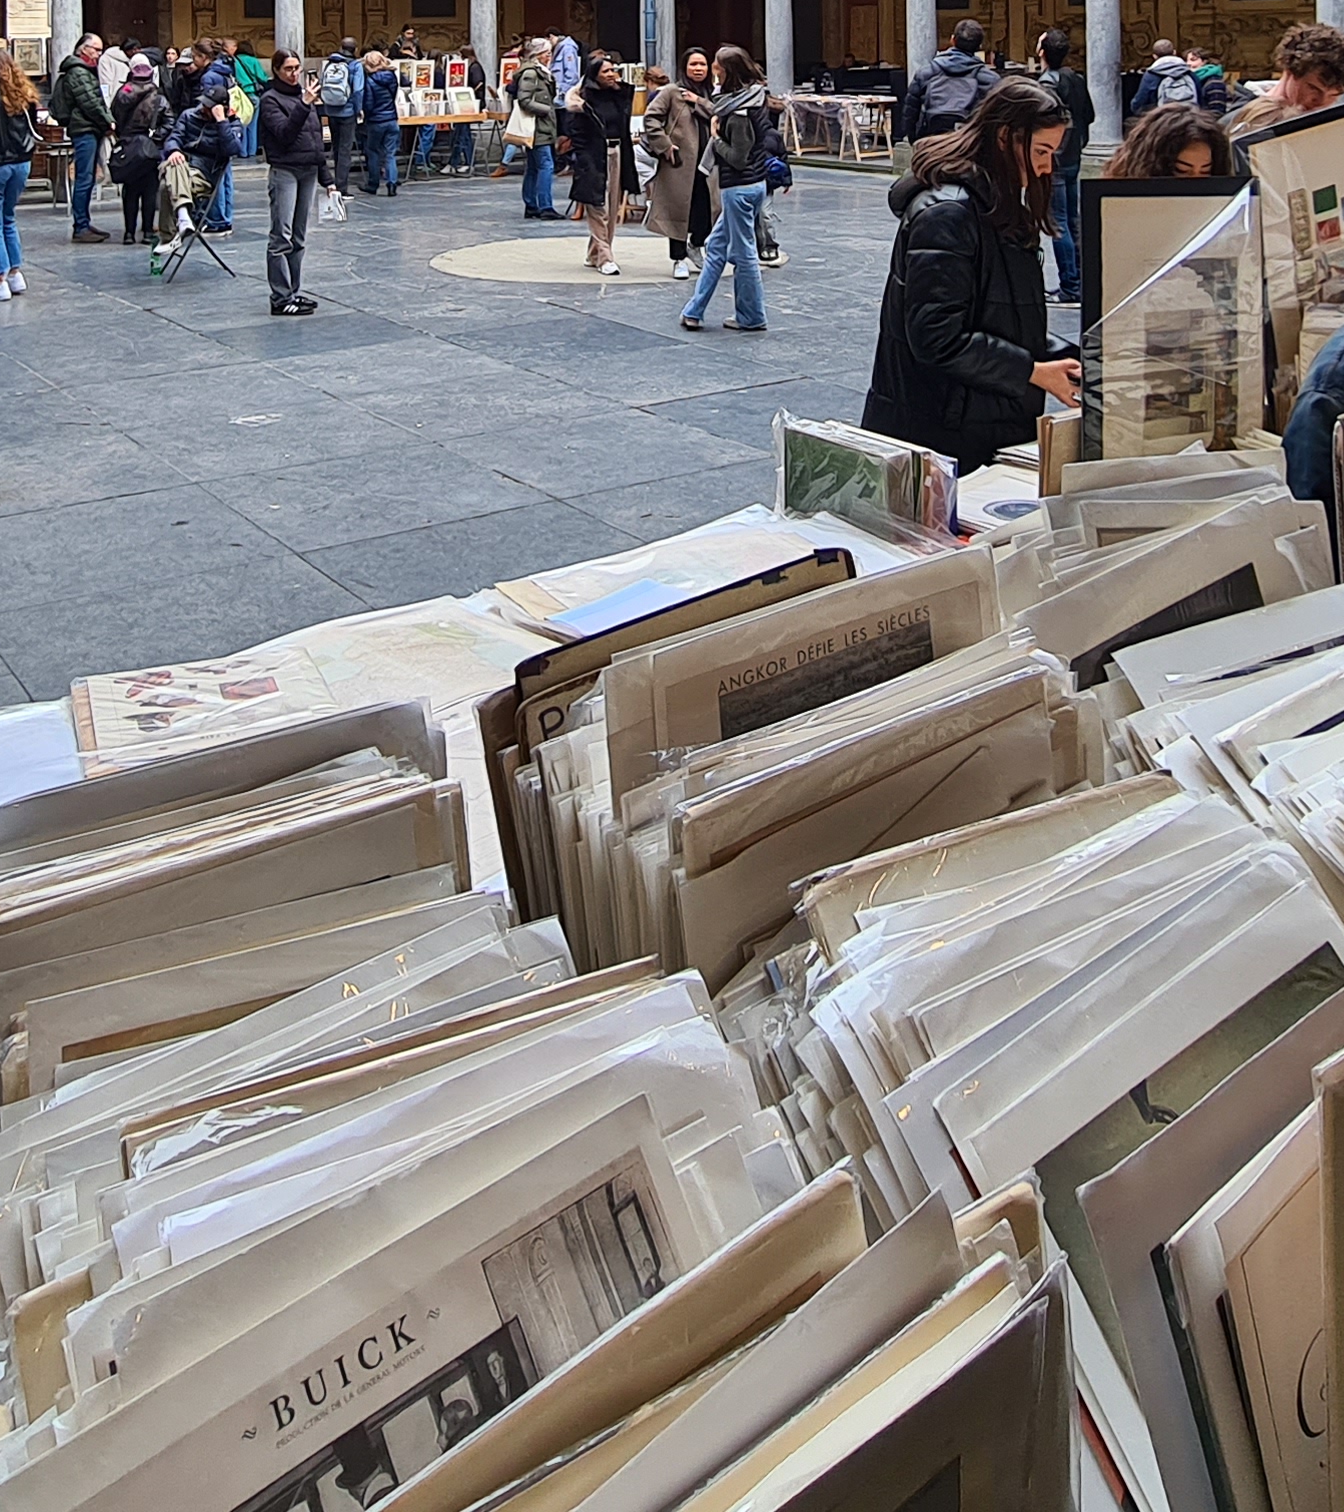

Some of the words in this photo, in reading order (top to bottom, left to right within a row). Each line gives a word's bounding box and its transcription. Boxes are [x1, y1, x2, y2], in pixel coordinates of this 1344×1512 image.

[717, 656, 788, 697] ANGKOR
[796, 636, 836, 666] DÉFIE
[843, 626, 868, 648] LES
[877, 604, 931, 637] SIÈCLES
[268, 1313, 416, 1432] BUICK
